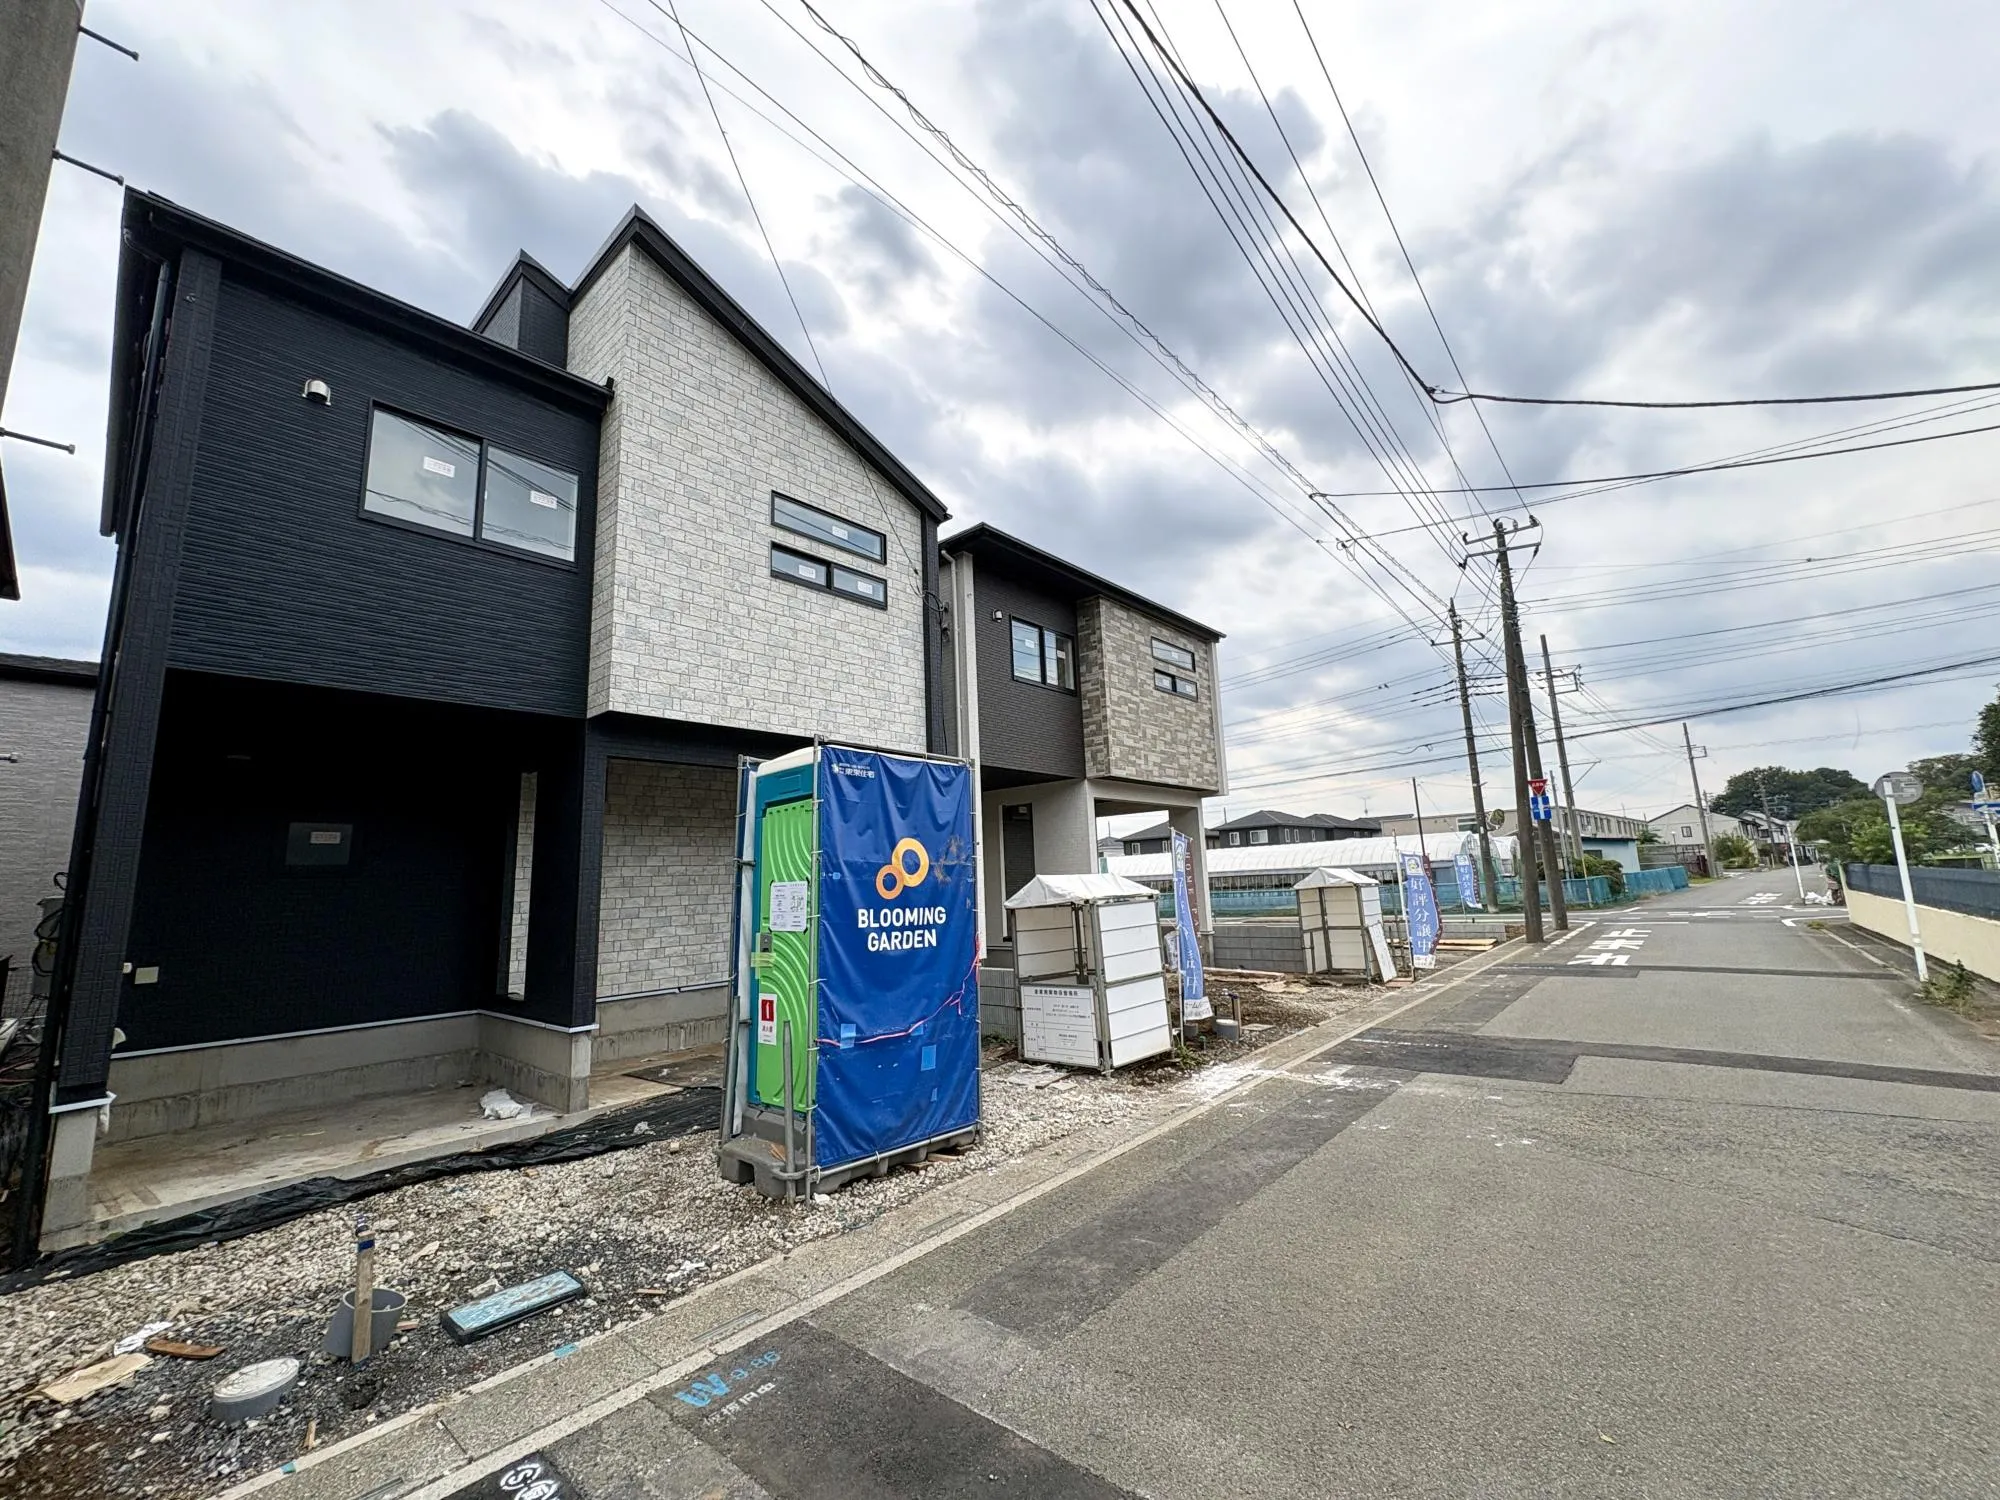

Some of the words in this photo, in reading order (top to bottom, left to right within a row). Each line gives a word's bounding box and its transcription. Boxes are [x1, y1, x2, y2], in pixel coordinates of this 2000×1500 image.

[858, 906, 947, 928] BLOOMING
[1411, 877, 1432, 953] 好評分譲中
[867, 929, 937, 952] GARDEN
[673, 1373, 730, 1407] W
